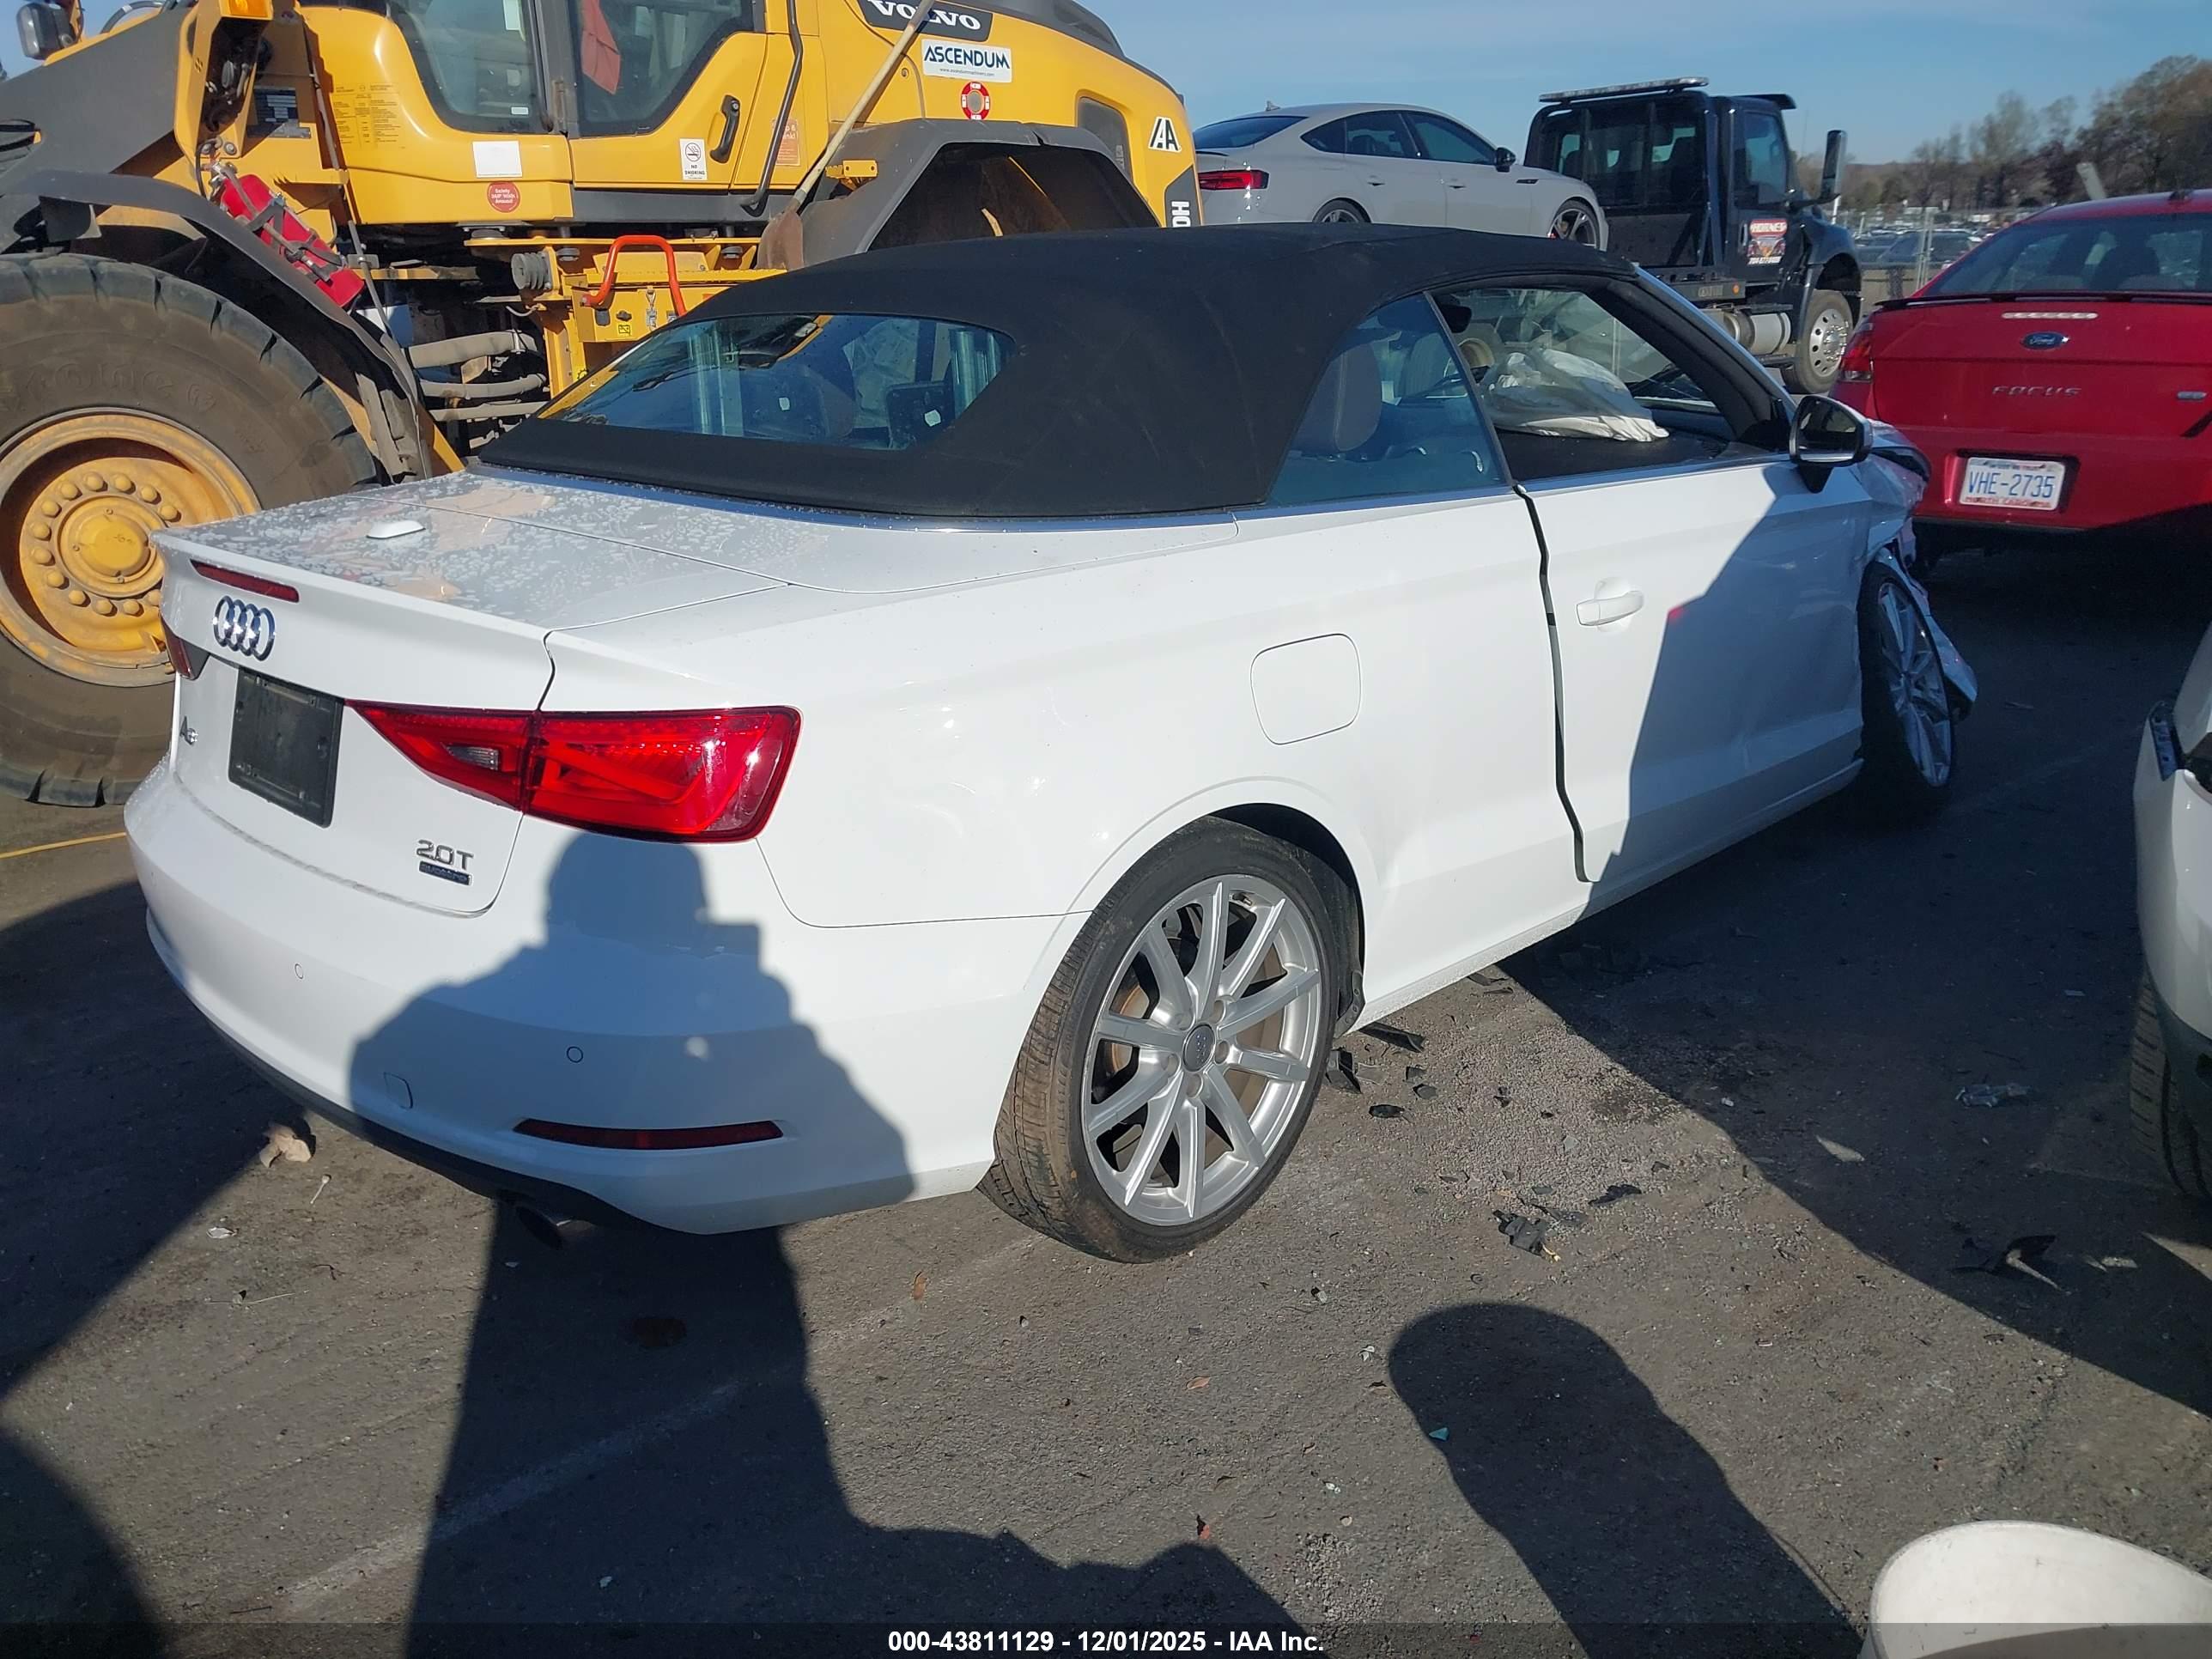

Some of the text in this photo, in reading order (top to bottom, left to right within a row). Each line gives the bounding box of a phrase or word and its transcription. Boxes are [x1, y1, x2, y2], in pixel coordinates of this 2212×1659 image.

[924, 46, 1011, 70] ASCENDUM
[2027, 332, 2057, 345] Ford
[1992, 386, 2081, 396] FOCUS
[1968, 471, 2056, 498] VHE-2735
